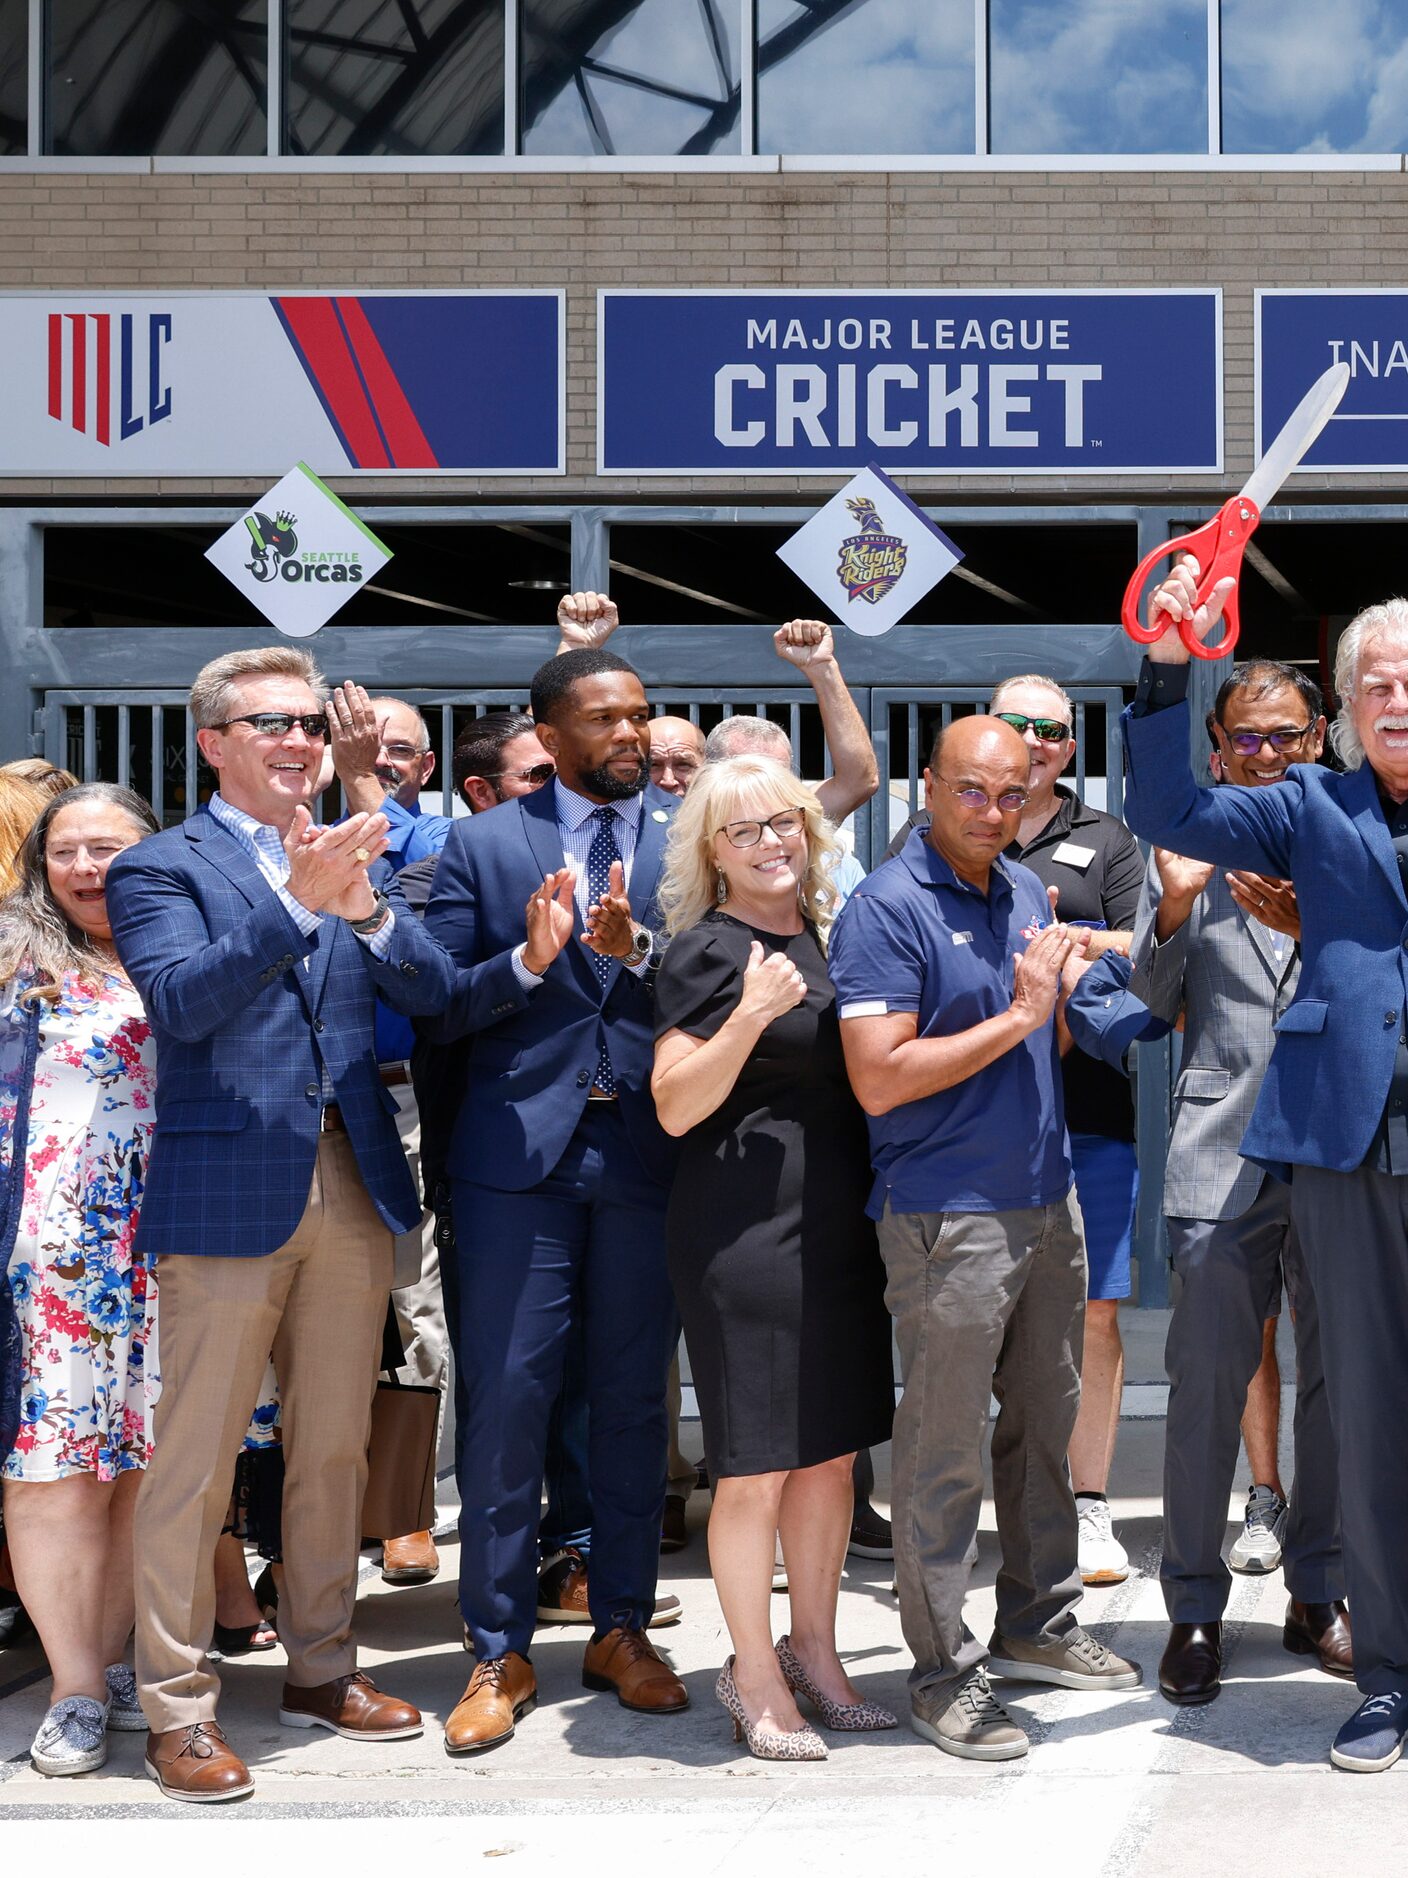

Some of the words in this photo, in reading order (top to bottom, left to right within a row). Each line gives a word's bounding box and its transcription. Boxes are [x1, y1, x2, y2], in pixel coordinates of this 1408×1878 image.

[747, 318, 892, 350] MAJOR
[911, 318, 1070, 350] LEAGUE
[48, 313, 172, 447] MLC
[714, 364, 1102, 447] CRICKET
[846, 537, 861, 545] LOS
[864, 536, 900, 545] ANGELES
[301, 552, 359, 563] SEATTLE
[841, 544, 906, 569] Knight
[281, 559, 363, 582] Orcas
[839, 557, 905, 586] Riders
